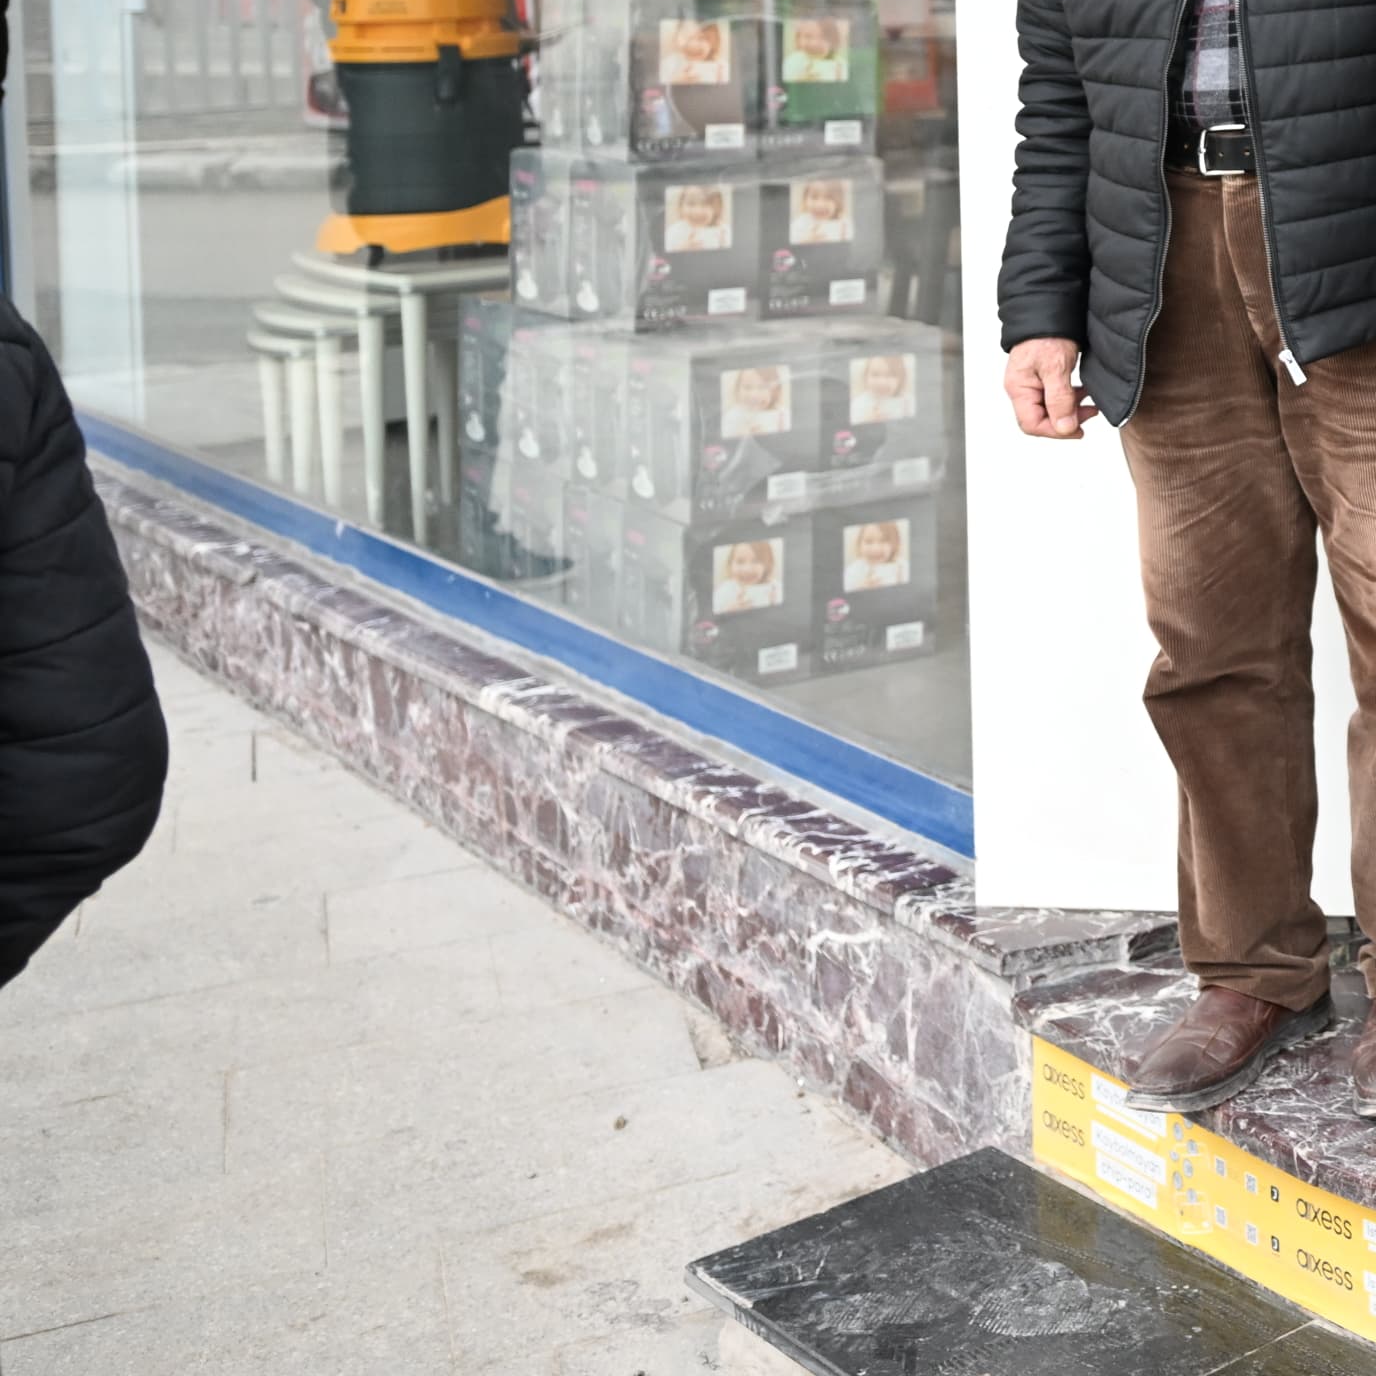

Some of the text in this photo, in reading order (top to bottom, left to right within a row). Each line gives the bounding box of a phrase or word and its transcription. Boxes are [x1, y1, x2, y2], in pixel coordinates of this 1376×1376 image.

[1042, 1062, 1086, 1101] axess
[1042, 1110, 1086, 1147] axess
[1295, 1196, 1354, 1241] axess
[1295, 1246, 1354, 1292] axess
